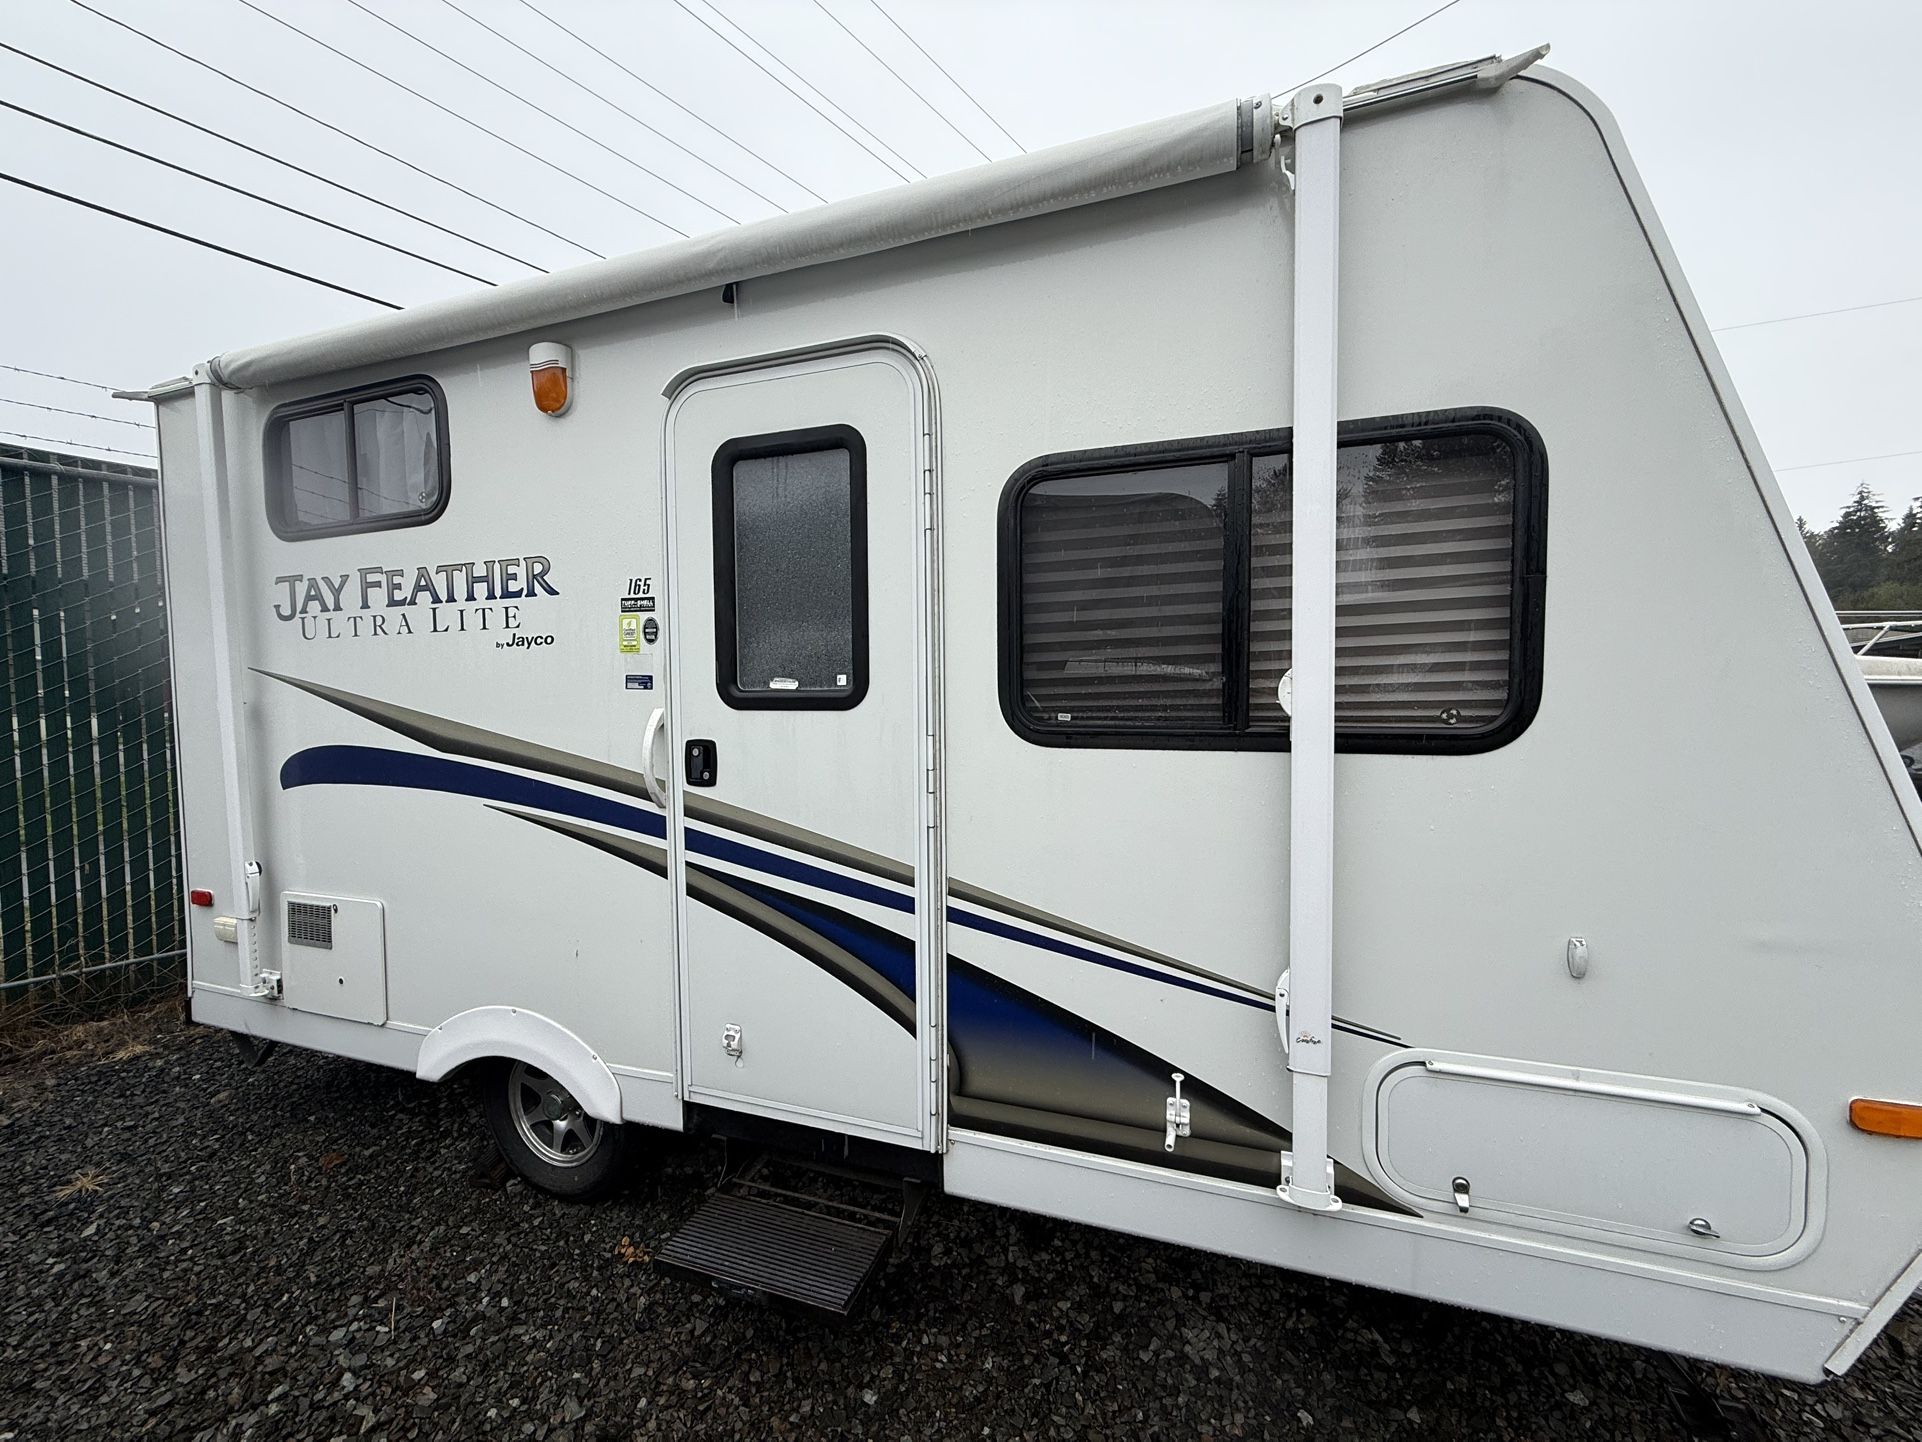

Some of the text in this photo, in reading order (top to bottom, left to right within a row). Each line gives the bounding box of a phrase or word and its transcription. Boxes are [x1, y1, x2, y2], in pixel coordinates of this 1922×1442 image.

[273, 555, 560, 621] JAY FEATHER
[627, 577, 652, 596] 165
[298, 605, 521, 640] ULTRA LITE
[495, 633, 555, 650] by Jayco
